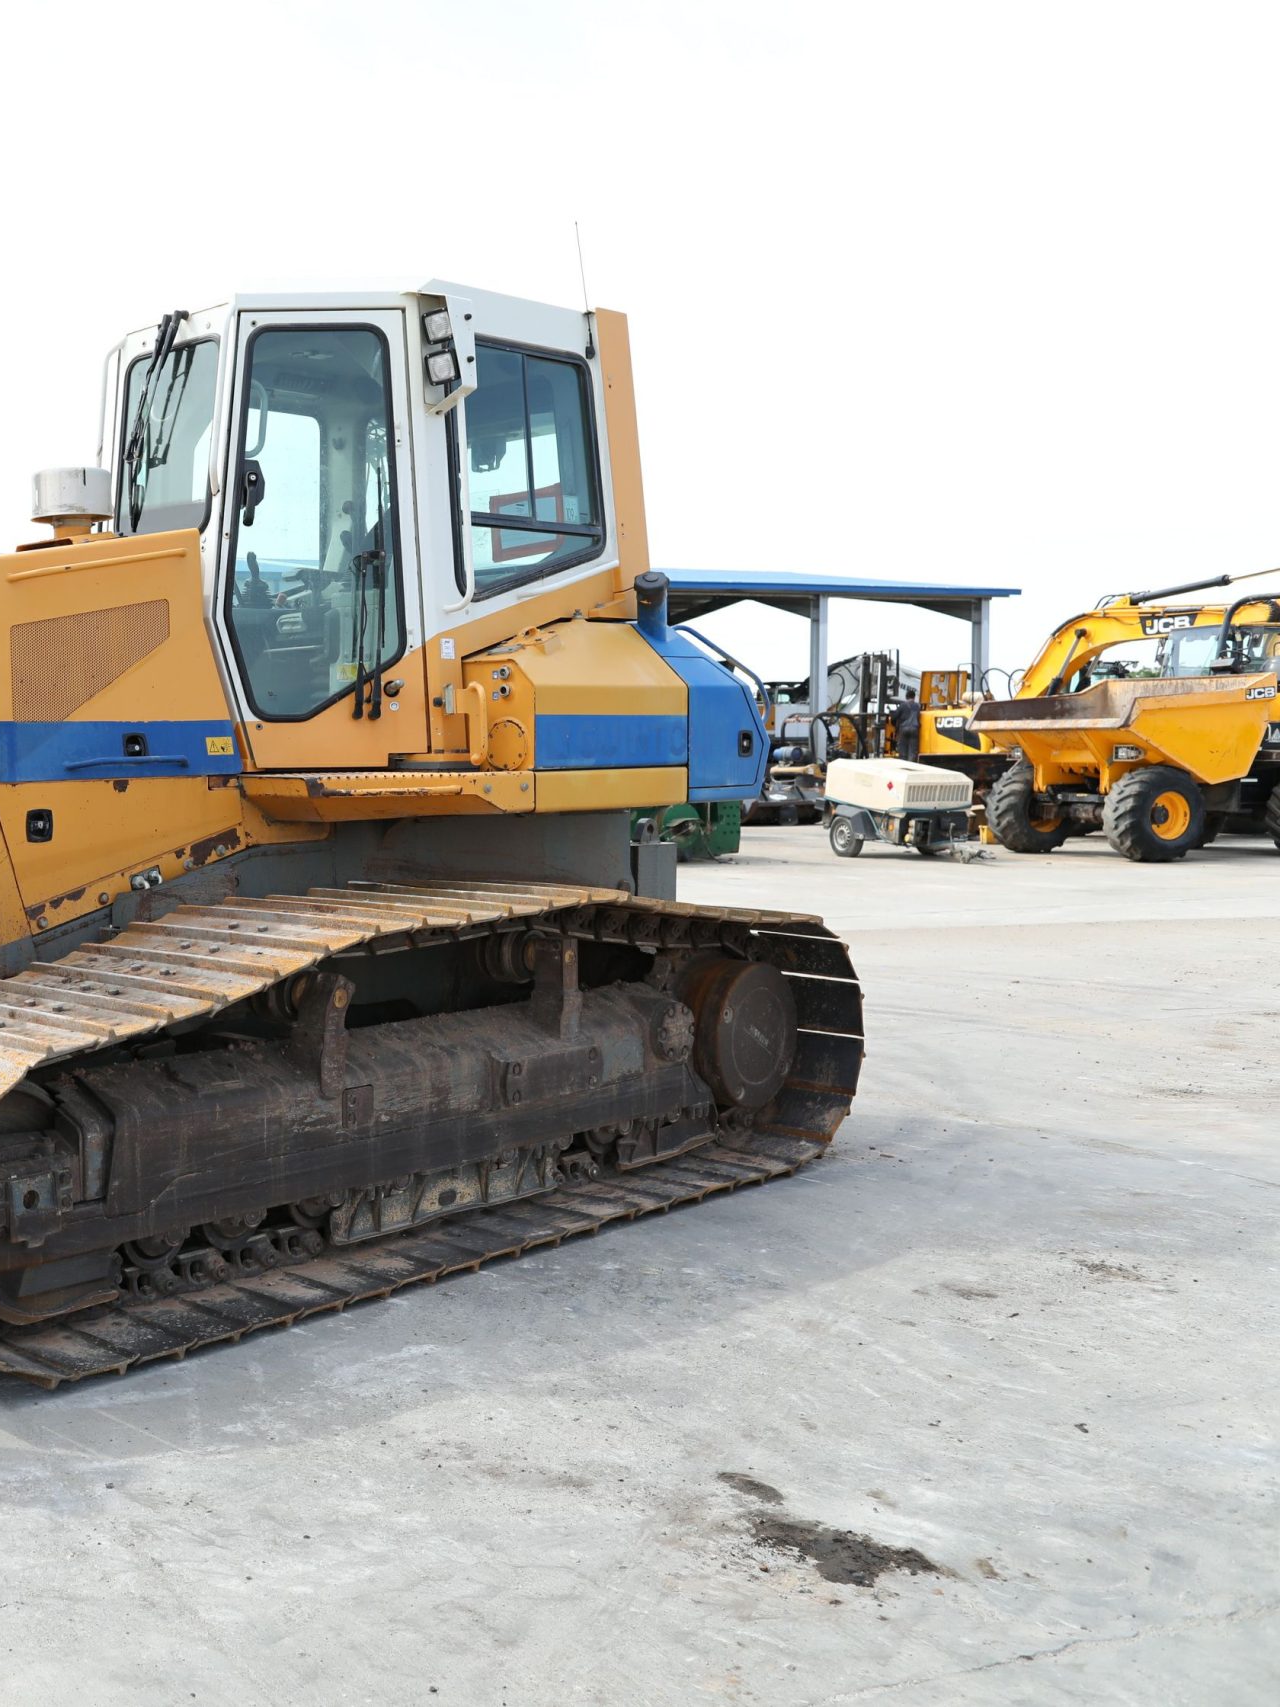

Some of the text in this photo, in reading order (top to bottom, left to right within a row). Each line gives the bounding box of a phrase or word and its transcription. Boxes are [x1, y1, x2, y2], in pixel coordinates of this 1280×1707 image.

[1145, 616, 1190, 635] JCB
[1246, 687, 1275, 700] JCB
[936, 717, 963, 728] JCB
